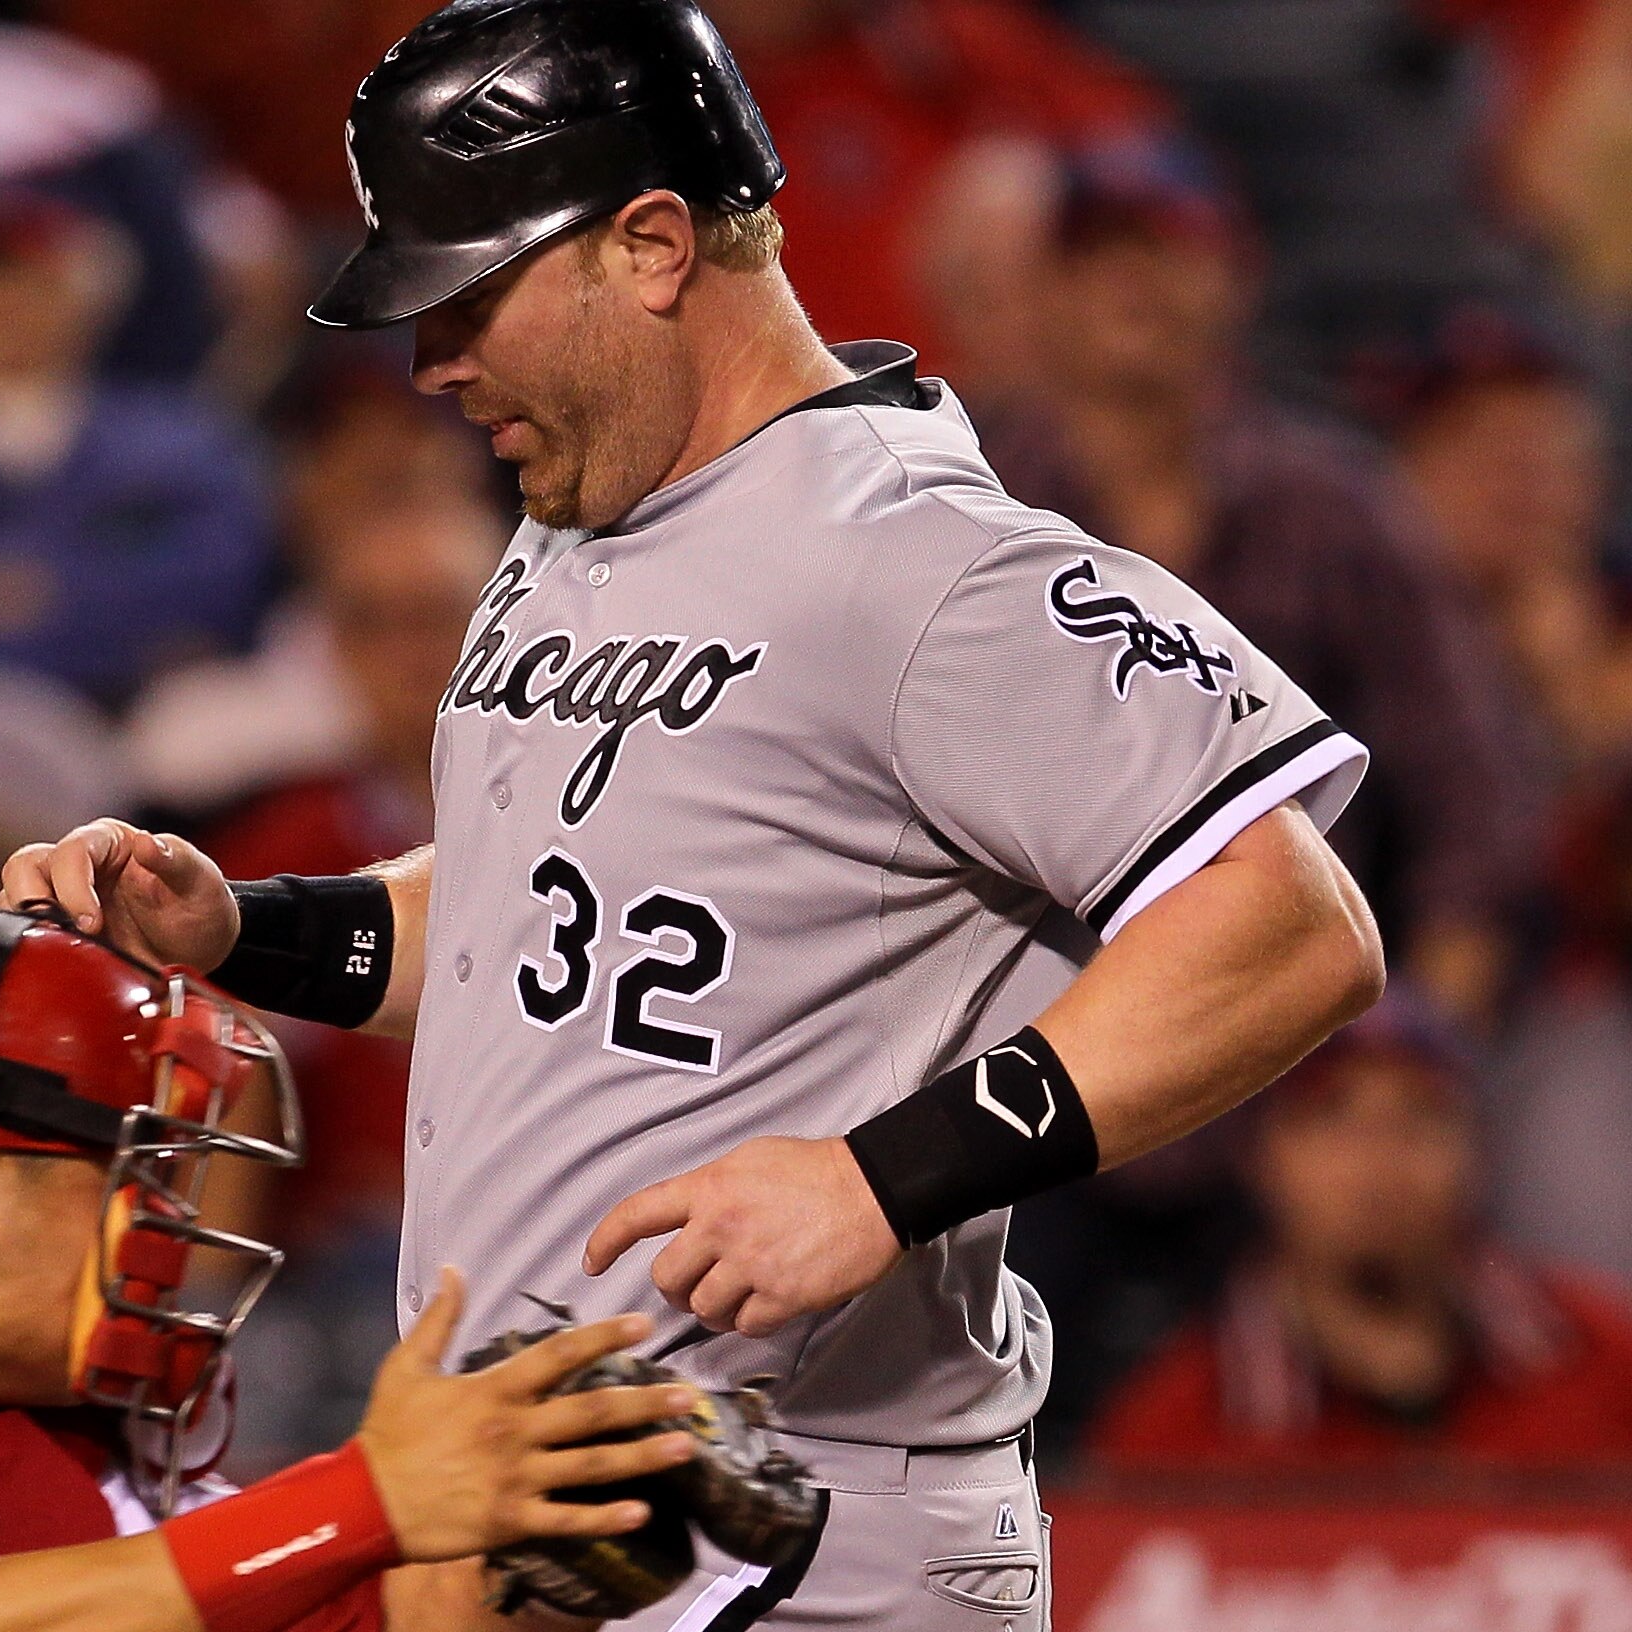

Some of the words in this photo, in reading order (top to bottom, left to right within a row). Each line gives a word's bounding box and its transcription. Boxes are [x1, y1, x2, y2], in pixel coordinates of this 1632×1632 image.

[436, 553, 769, 831] hicago
[1045, 555, 1238, 702] Sox
[513, 846, 736, 1074] 32
